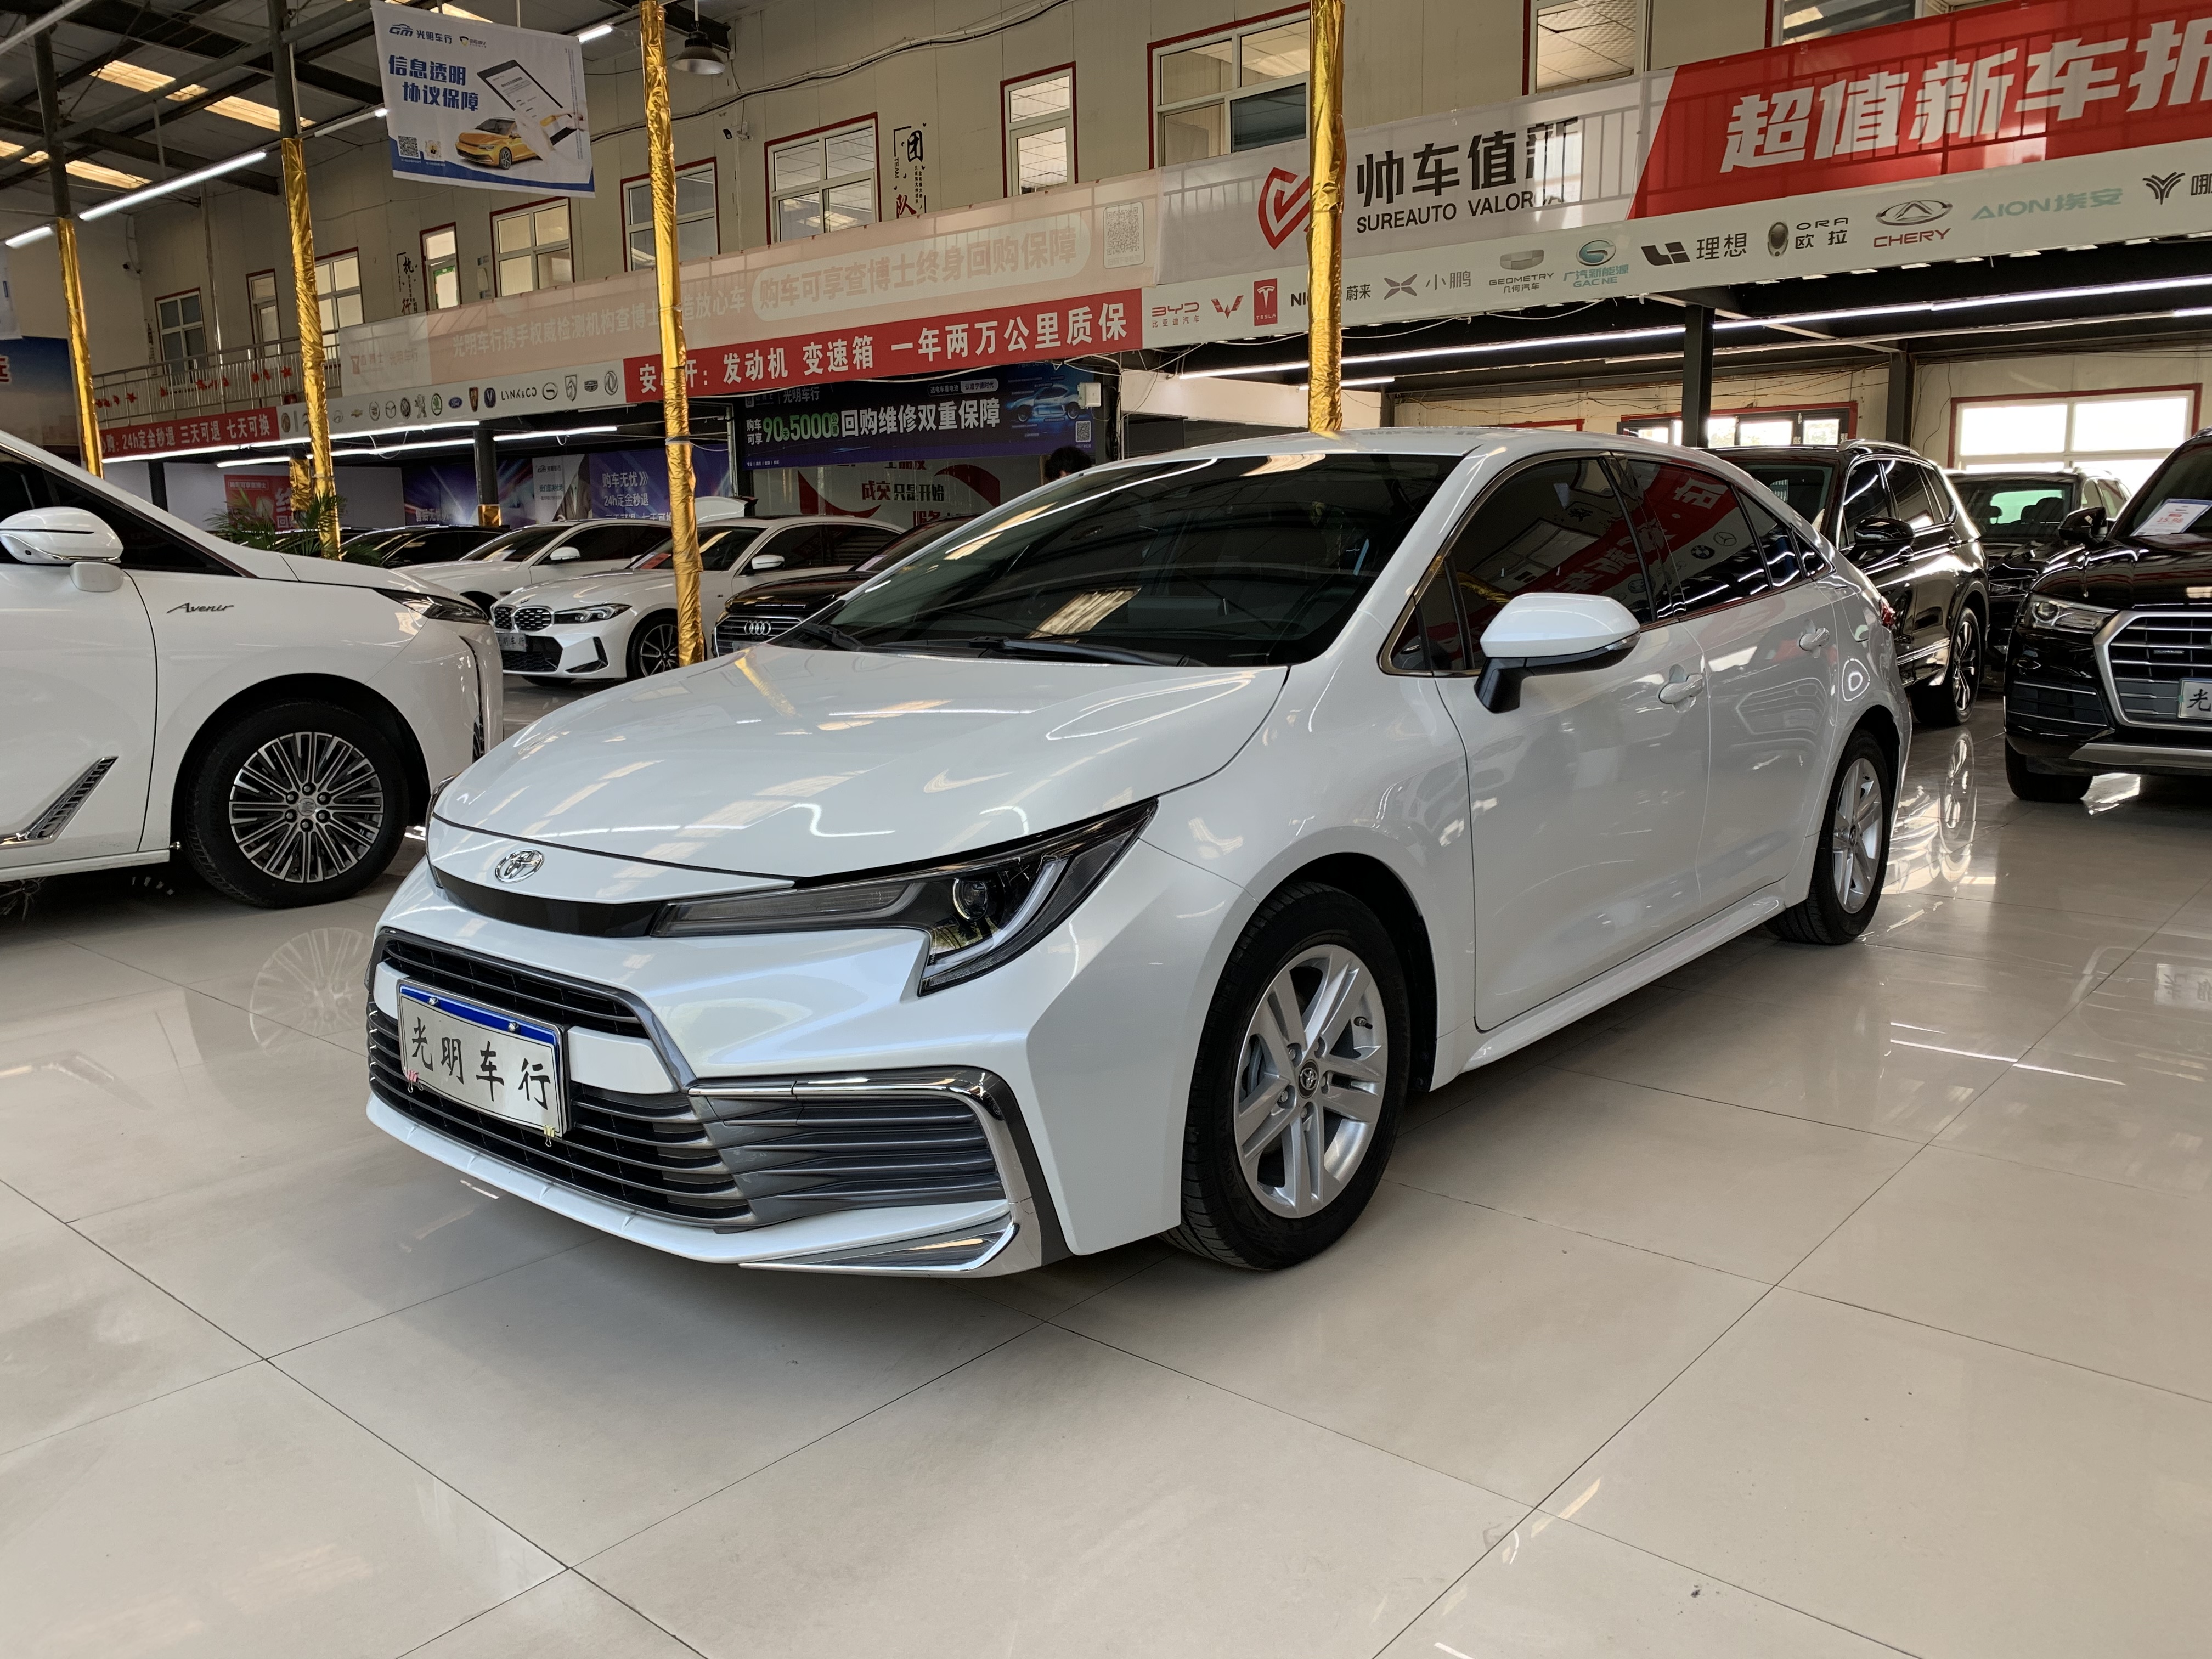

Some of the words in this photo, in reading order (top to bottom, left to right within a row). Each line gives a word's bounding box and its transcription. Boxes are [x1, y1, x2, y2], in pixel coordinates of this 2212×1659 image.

[416, 29, 452, 44] 光明车行
[388, 54, 466, 86] 信息透明
[402, 81, 478, 111] 协议保障
[1356, 202, 1457, 234] SUREAUTO
[1796, 217, 1849, 230] ORA
[1696, 232, 1747, 261] 理想
[1795, 229, 1848, 250] 欧拉
[1874, 228, 1951, 248] CHERY
[759, 226, 1076, 310] 购车可享查博士终身回购保障
[1563, 264, 1629, 281] 广汽新能源
[1425, 271, 1471, 291] 小鹏
[1489, 273, 1554, 286] GEOMETRY
[1503, 283, 1540, 294] 几何汽车
[1290, 292, 1309, 307] NI
[1346, 284, 1371, 301] 蔚来
[453, 285, 746, 358] 光明车行携手权威检测机构查博士造放心车
[1152, 315, 1200, 328] 比亚迪汽车
[723, 347, 788, 385] 发动机
[803, 335, 873, 376] 变速箱
[890, 302, 1127, 362] 一年两万公里质保
[783, 386, 820, 404] 光明车行
[746, 418, 762, 431] 购车
[841, 397, 1000, 437] 回购维修双重保障
[180, 420, 221, 444] 三天可退
[227, 413, 270, 439] 七天可换
[747, 432, 763, 445] 可享
[602, 471, 637, 488] 购车无忧
[604, 493, 649, 507] 24h定金秒退
[166, 602, 234, 614] Avenir
[2187, 689, 2211, 712] 光
[411, 1017, 551, 1110] 光明车行
